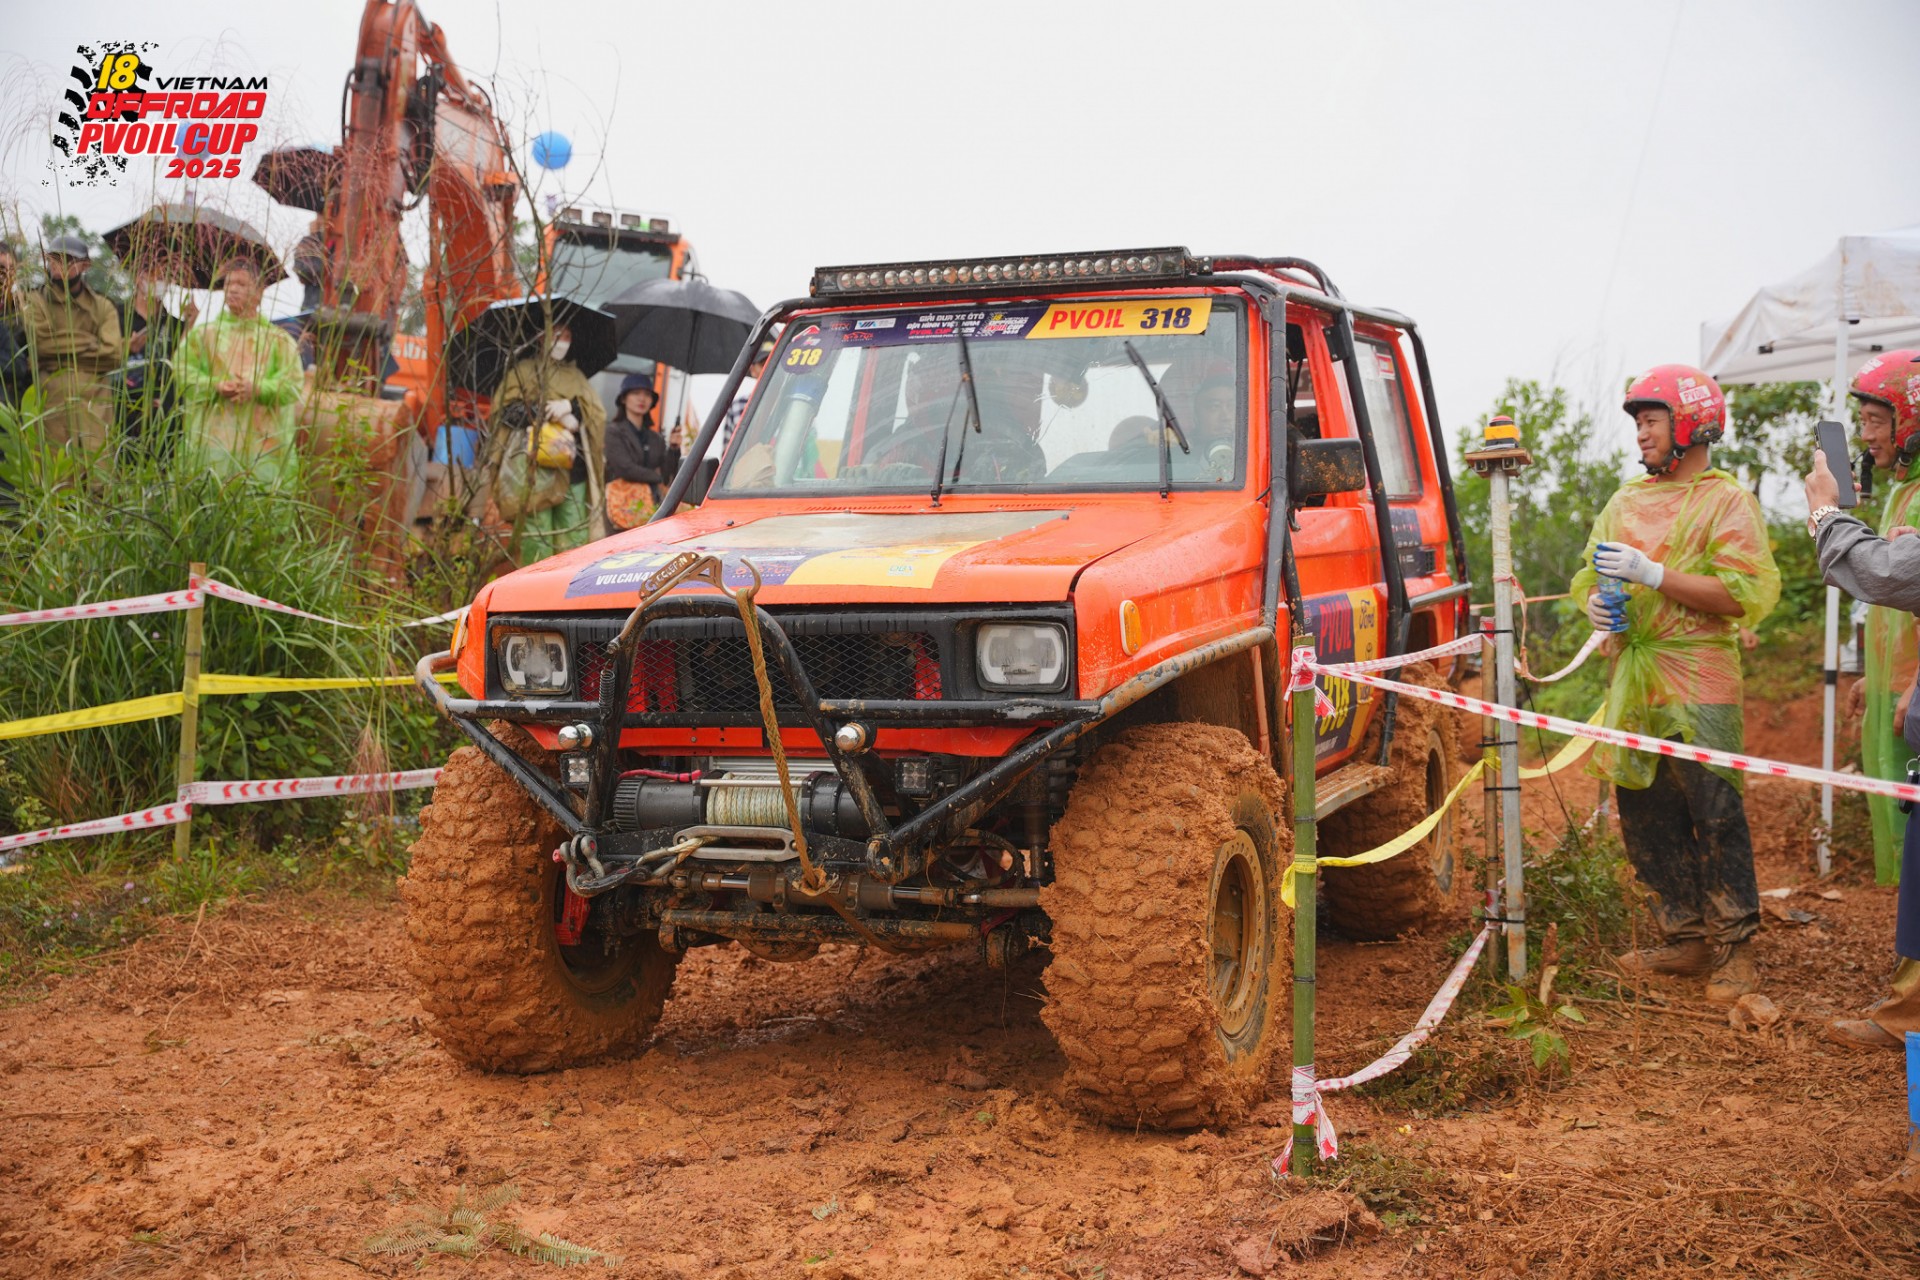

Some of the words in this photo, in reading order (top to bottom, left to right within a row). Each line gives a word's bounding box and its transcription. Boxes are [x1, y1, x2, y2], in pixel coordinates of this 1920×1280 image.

[1049, 307, 1124, 330] PVOIL
[1140, 307, 1192, 329] 318
[786, 348, 823, 366] 318
[1318, 600, 1352, 657] PVOIL
[1359, 599, 1375, 630] Ford
[1318, 664, 1351, 737] 318
